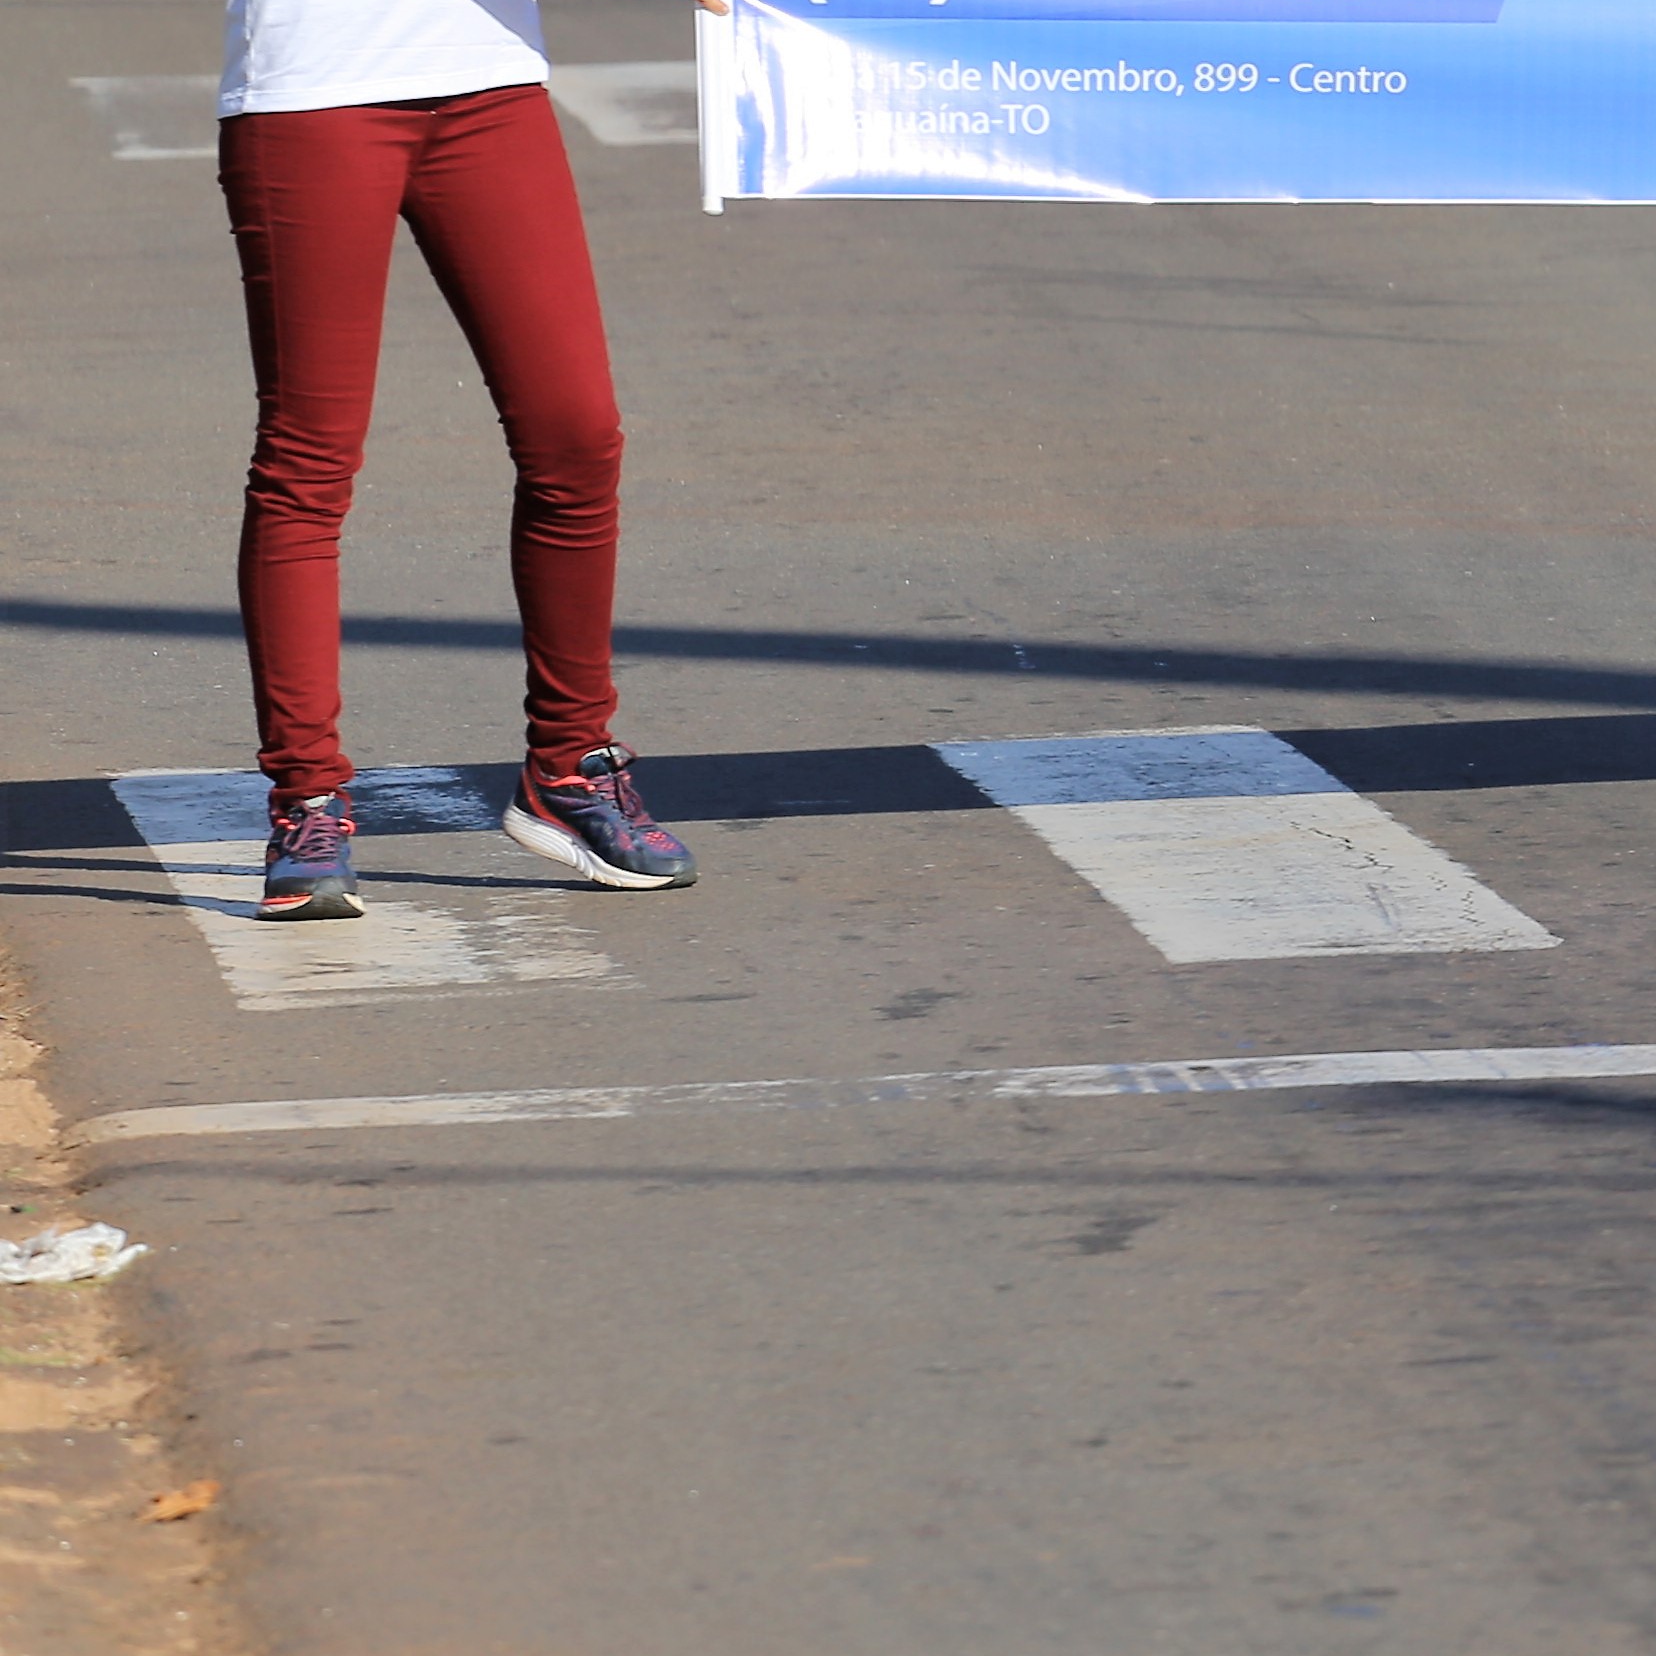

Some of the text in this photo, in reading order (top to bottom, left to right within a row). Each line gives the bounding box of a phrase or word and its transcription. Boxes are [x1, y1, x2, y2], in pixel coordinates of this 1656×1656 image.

[938, 58, 980, 91] de
[993, 60, 1185, 97] Novembro,
[1194, 62, 1257, 94] 899
[1290, 63, 1408, 95] Centro
